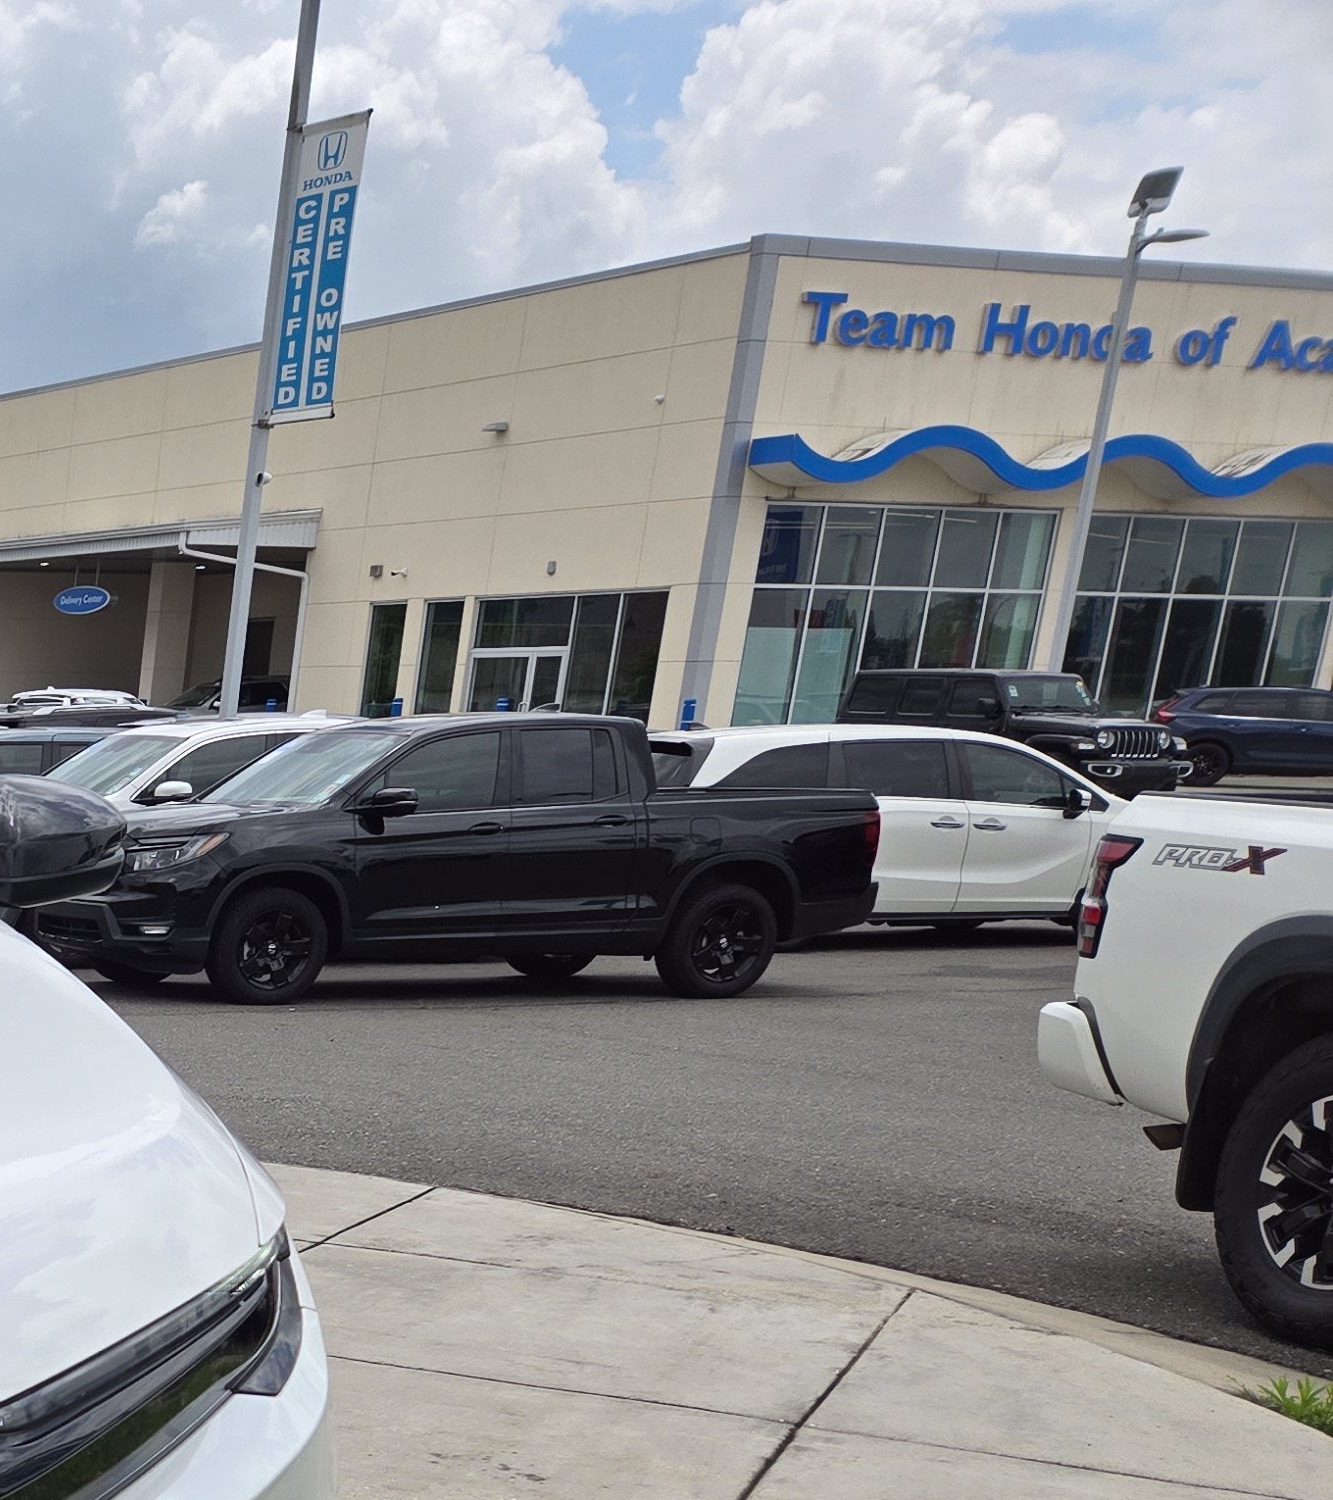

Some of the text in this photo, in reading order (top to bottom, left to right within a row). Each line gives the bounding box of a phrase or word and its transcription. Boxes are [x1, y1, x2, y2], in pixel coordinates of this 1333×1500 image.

[302, 171, 353, 191] HONDA
[277, 199, 317, 406] CERTIFIED
[311, 192, 350, 401] PRE OWNED
[803, 290, 956, 351] Team
[1176, 315, 1238, 367] of
[60, 594, 103, 606] Delivery Center
